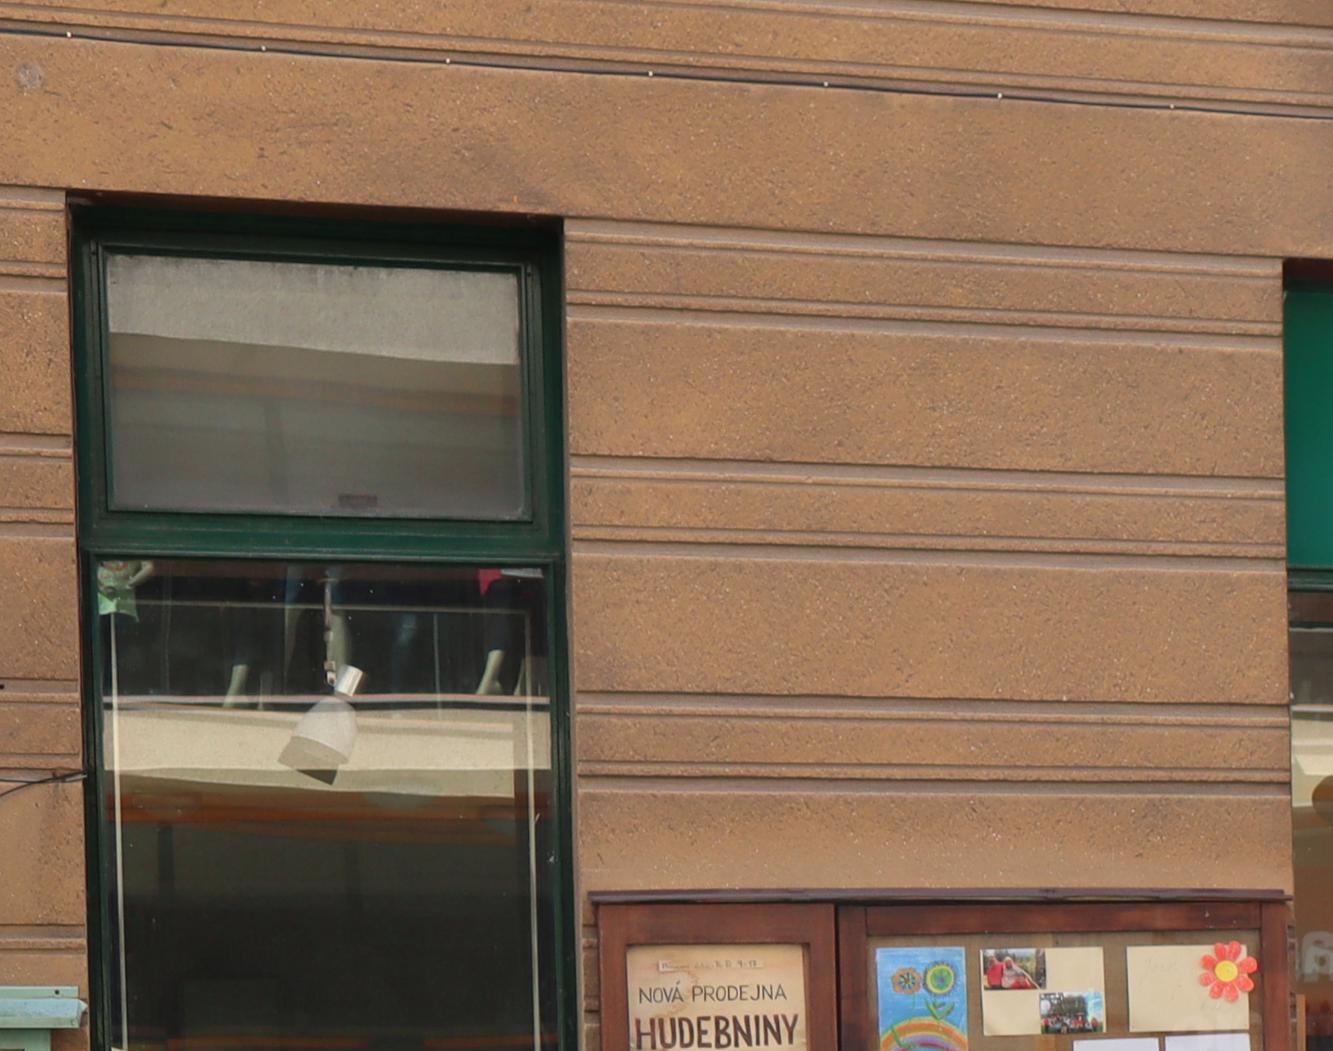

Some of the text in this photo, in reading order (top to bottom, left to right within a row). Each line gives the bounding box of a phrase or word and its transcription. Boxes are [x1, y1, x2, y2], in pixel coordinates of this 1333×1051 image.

[639, 980, 787, 1004] NOVÁ PRODEJNA
[634, 1014, 799, 1050] HUDEBNINY
